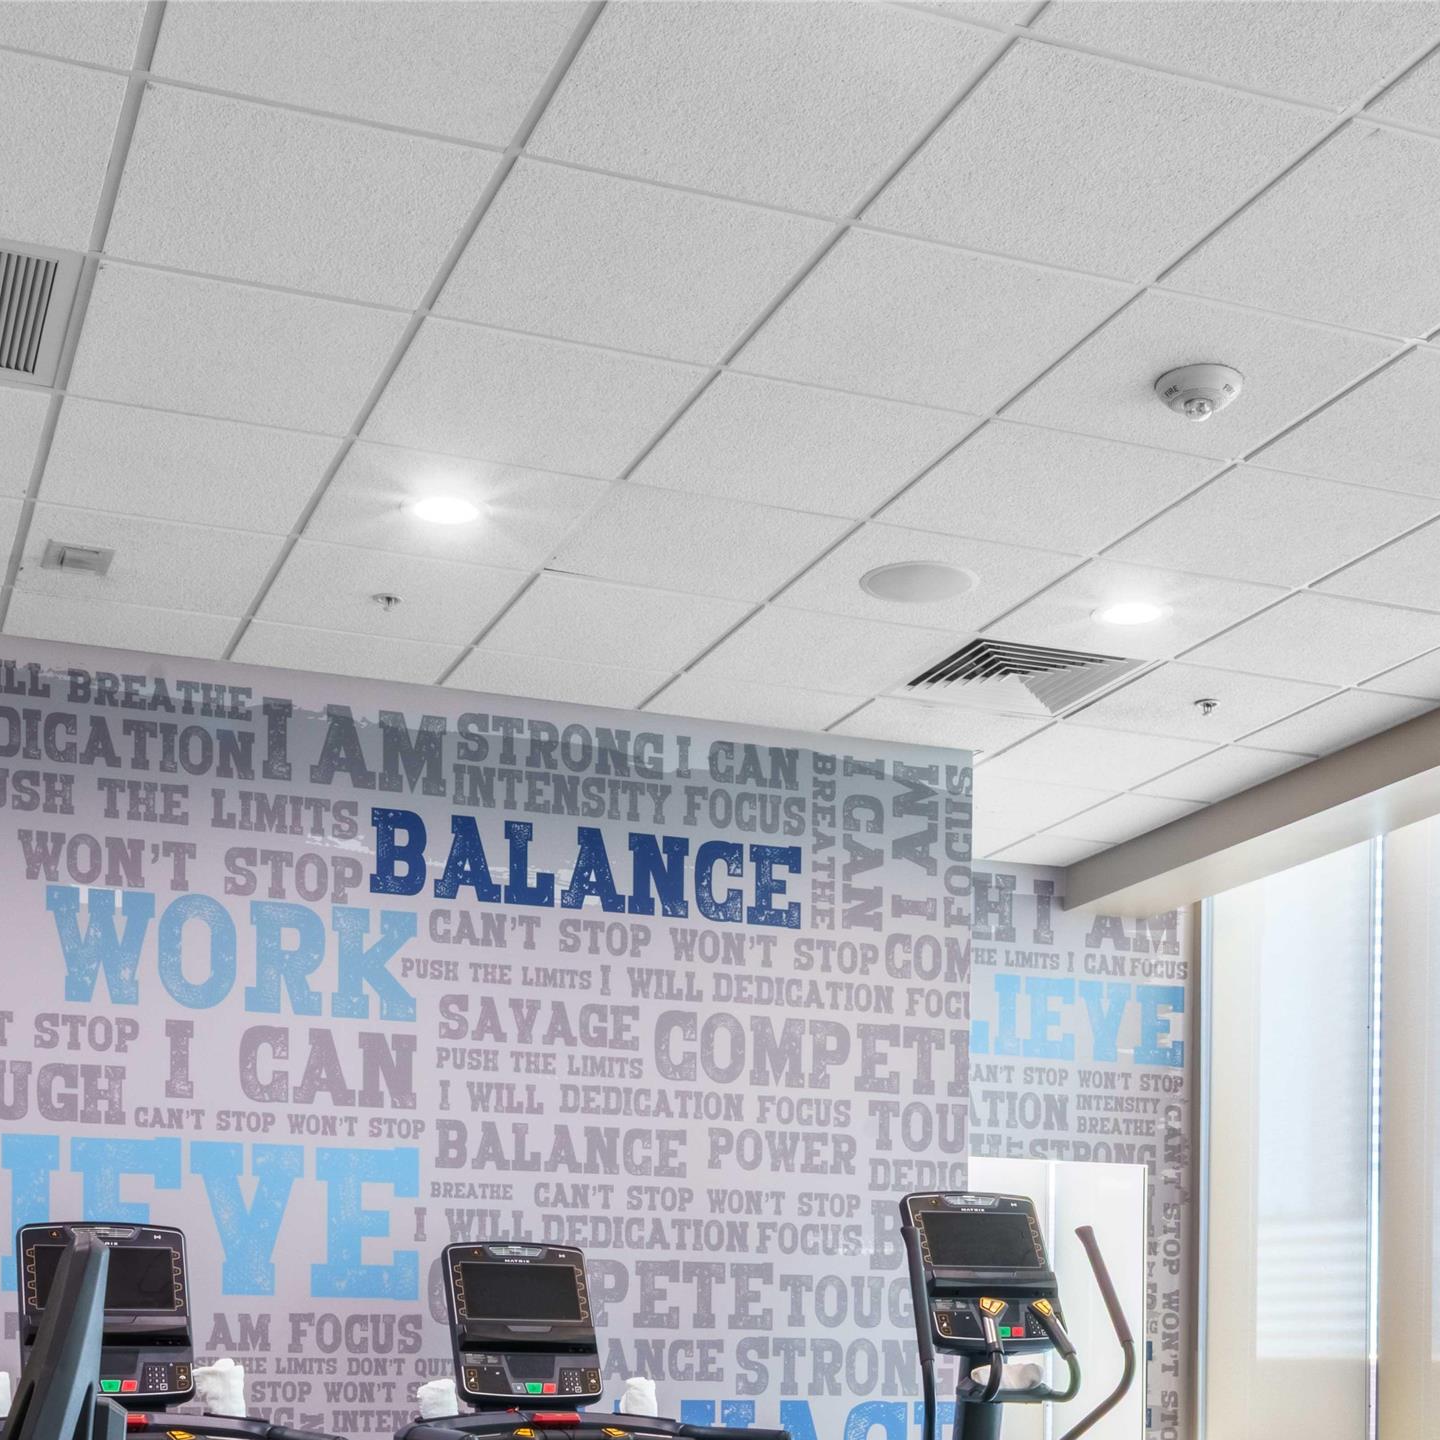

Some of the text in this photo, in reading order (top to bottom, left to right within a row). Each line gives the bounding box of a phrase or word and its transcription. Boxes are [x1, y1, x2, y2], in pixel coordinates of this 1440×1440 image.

[68, 669, 253, 722] BREATHE
[262, 696, 448, 798] I AM
[456, 713, 799, 791] STRONG I CAN
[97, 777, 189, 826] THE
[211, 789, 358, 840] LIMITS
[453, 763, 806, 837] INTENSITY FOCUS
[17, 828, 196, 891] WON'T
[223, 846, 363, 904] STOP
[811, 751, 836, 931] BREATHE
[842, 755, 885, 932] I CAN
[891, 760, 938, 921] I AM
[369, 807, 802, 929] BALANCE
[45, 885, 418, 1023] WORK
[429, 908, 878, 975] CAN'T STOP WON'T STOP
[1005, 951, 1189, 980] LIMITS I CAN FOCUS
[401, 958, 591, 990] PUSH THE LIMITS
[600, 965, 894, 1014] I WILL DEDICATION
[34, 1013, 140, 1053] STOP
[438, 994, 640, 1051] SAVAGE
[165, 1019, 417, 1110] I CAN
[436, 1046, 643, 1080] PUSH THE LIMITS
[1024, 1067, 1068, 1086] STOP
[1078, 1070, 1132, 1090] WON'T
[134, 1106, 425, 1140] CAN'T STOP WON'T STOP
[438, 1080, 851, 1128] I WILL DEDICATION FOCUS
[1076, 1095, 1160, 1114] INTENSITY
[1077, 1117, 1155, 1136] BREATHE
[435, 1119, 856, 1178] BALANCE POWER
[430, 1181, 862, 1218] BREATHE CAN'T STOP WON'T STOP
[414, 1207, 427, 1241] I
[445, 1208, 532, 1244] WILL
[555, 1213, 749, 1253] DEDICATION
[756, 1221, 863, 1256] FOCUS
[206, 1314, 422, 1354] AM FOCUS
[251, 1382, 312, 1402] STOP
[324, 1382, 395, 1403] WON'T
[275, 1358, 337, 1376] LIMITS
[346, 1358, 405, 1376] DON'T
